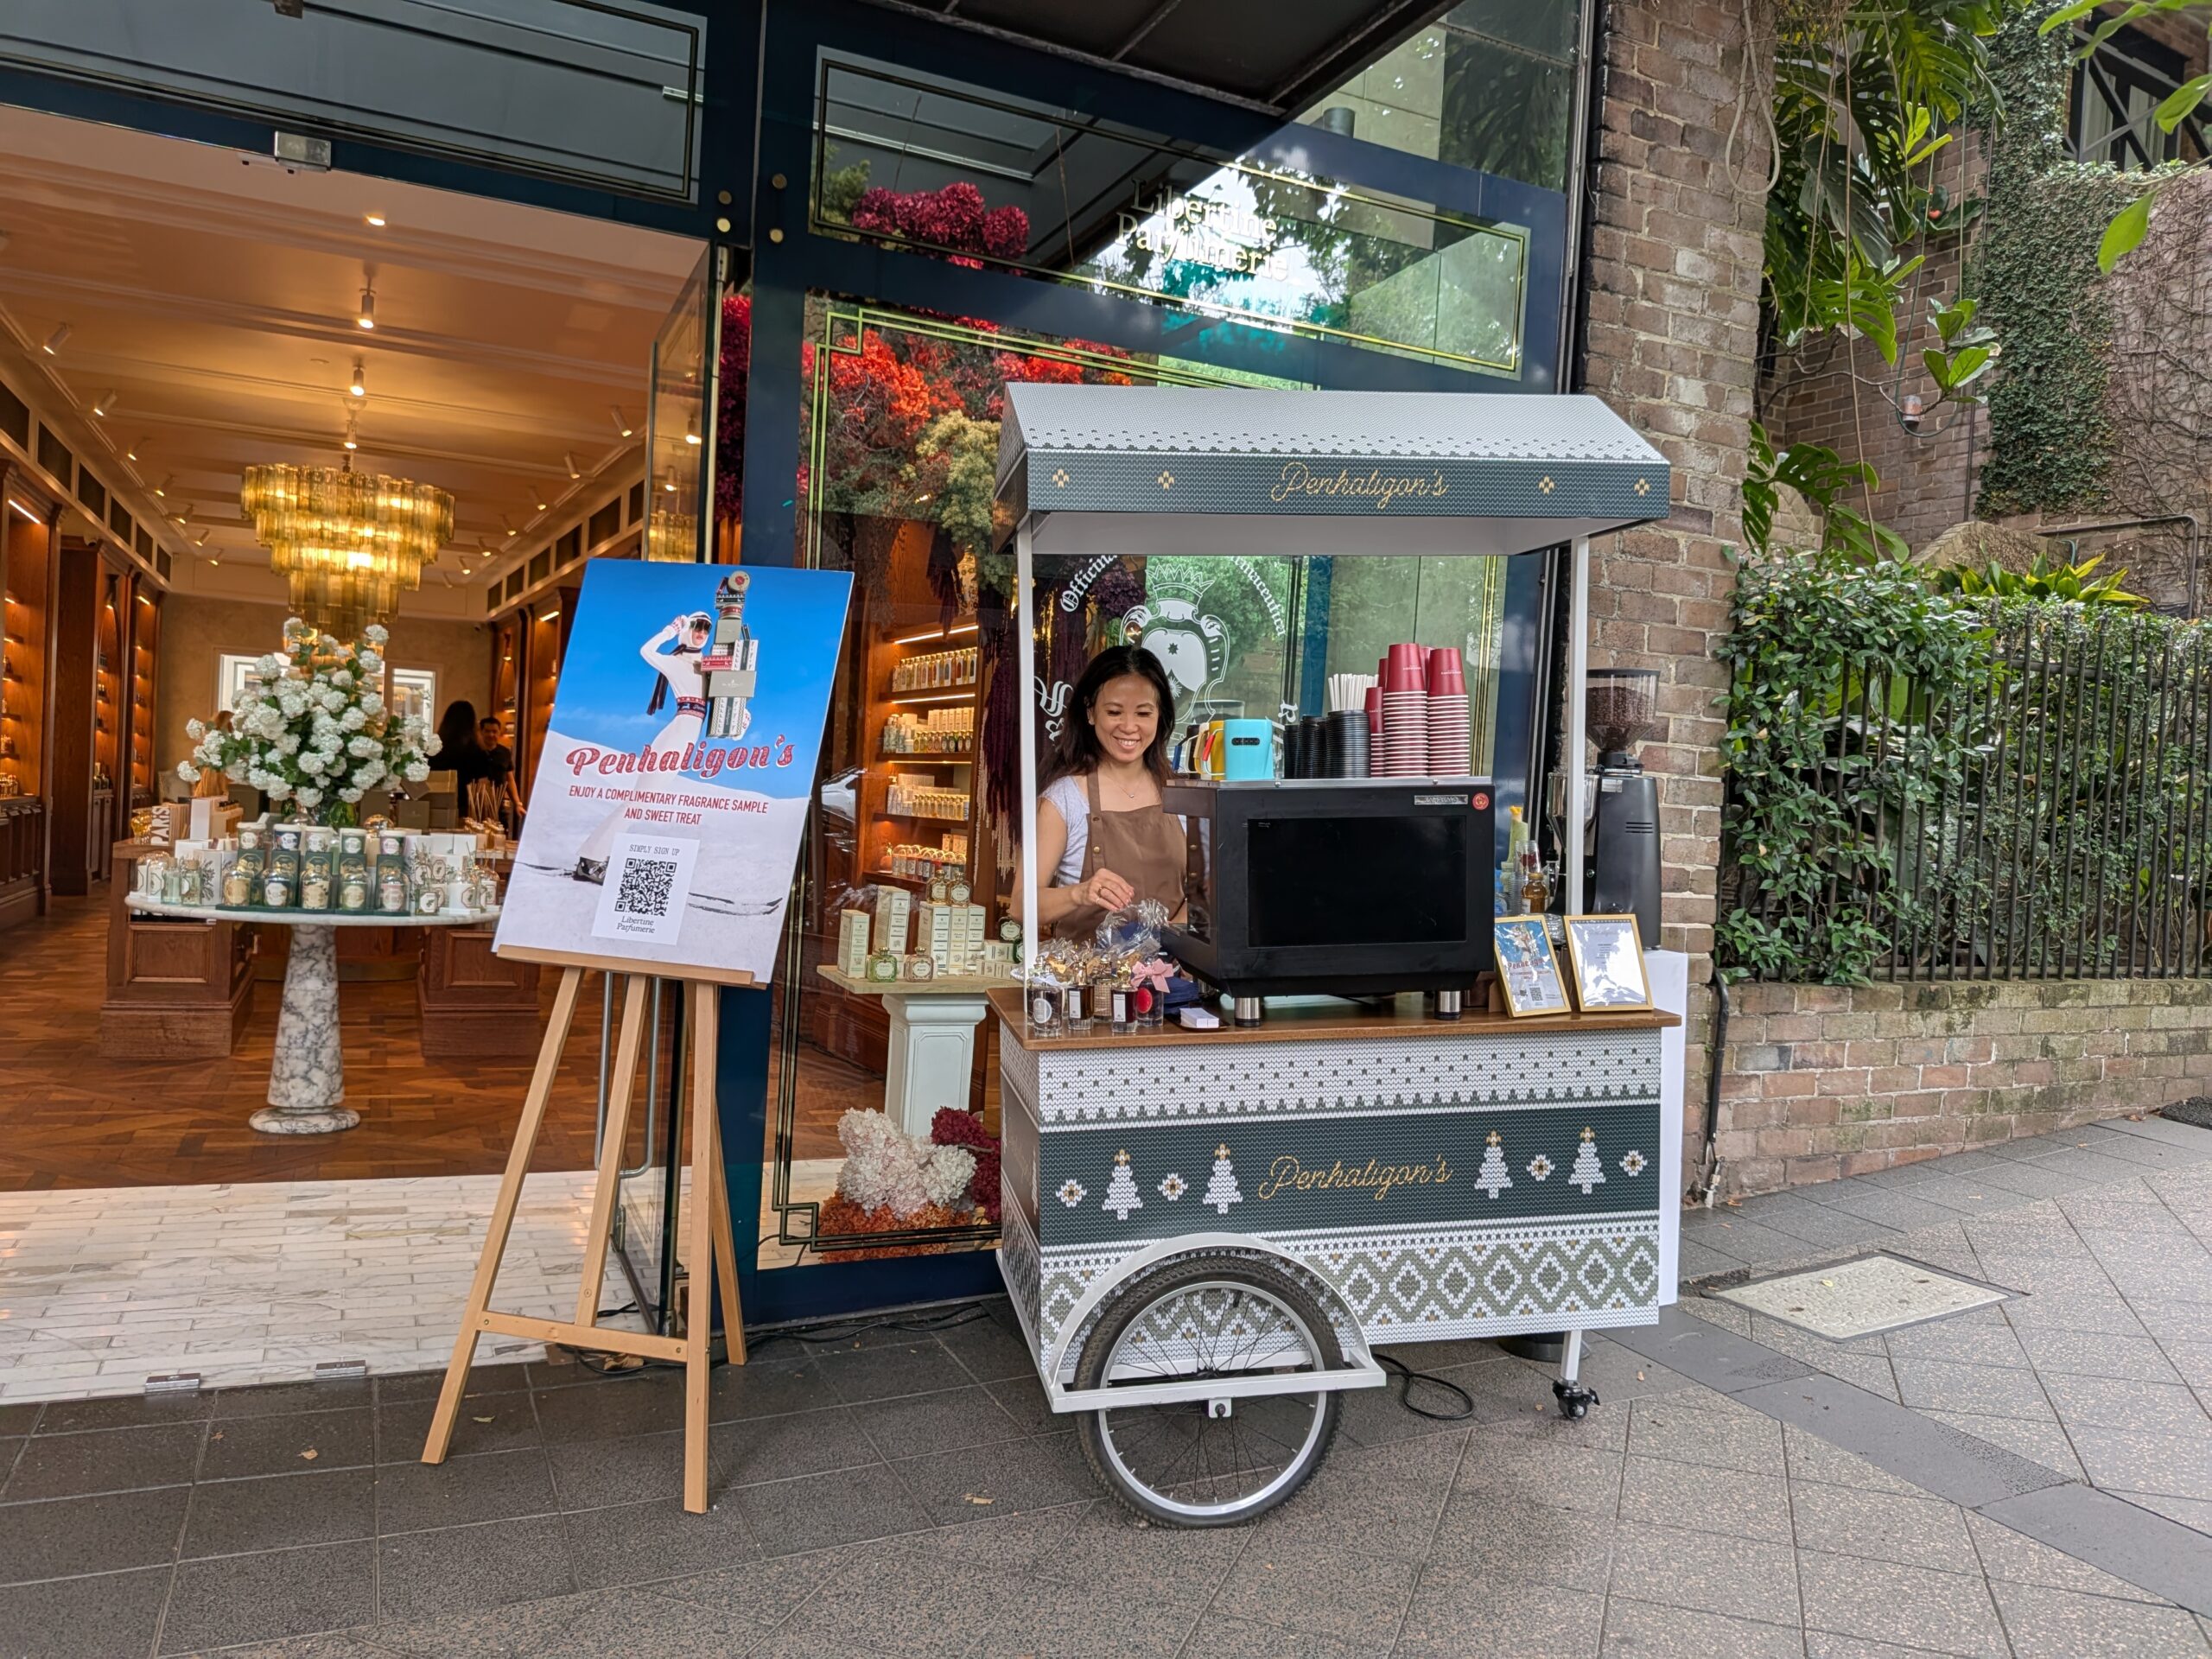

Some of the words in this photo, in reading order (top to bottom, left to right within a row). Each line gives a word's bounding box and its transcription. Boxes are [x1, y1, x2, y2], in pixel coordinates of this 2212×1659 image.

[1130, 177, 1278, 242] Libertine
[1115, 212, 1288, 282] Parfumerie
[1270, 461, 1450, 510] Penhaligon's
[1230, 555, 1287, 637] rmaceutica
[566, 734, 796, 779] Penhaligon's
[569, 785, 597, 798] ENJOY
[596, 787, 603, 799] A
[605, 788, 677, 805] COMPLIMENTARY
[677, 794, 731, 810] FRAGRANCE
[731, 799, 769, 814] SAMPLE
[624, 807, 643, 820] AND
[644, 809, 674, 823] SWEET
[675, 811, 702, 825] TREAT
[629, 843, 652, 854] SIMPLY
[653, 846, 671, 855] SIGN
[671, 848, 681, 856] UP
[616, 922, 656, 933] Parfumerie
[621, 916, 655, 926] Libertine
[1258, 1154, 1453, 1200] Penhaligon's
